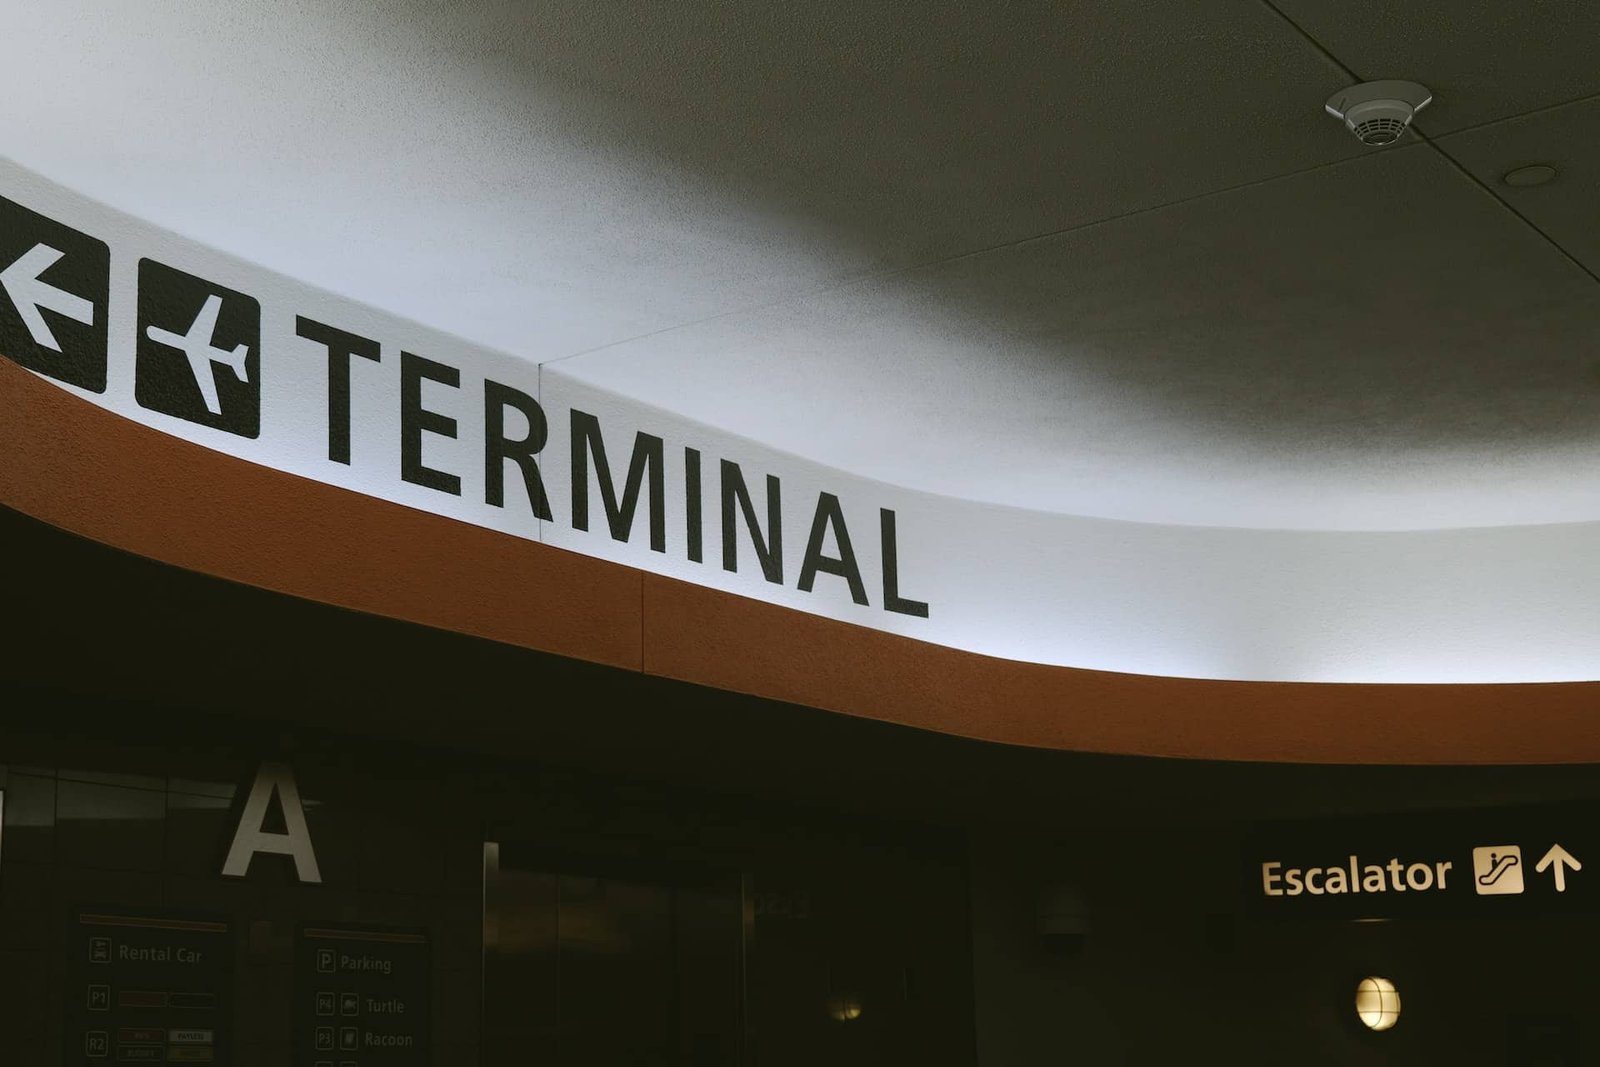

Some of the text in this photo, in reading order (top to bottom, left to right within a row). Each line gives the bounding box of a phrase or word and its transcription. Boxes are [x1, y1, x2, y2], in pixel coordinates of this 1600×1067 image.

[295, 314, 930, 619] TERMINAL
[221, 763, 322, 883] A
[1262, 856, 1453, 898] Escalator
[119, 944, 203, 964] Rental Car
[320, 952, 392, 974] P Parking
[91, 990, 106, 1007] P1
[366, 998, 405, 1014] Turtle
[89, 1037, 105, 1051] R2
[318, 1031, 413, 1046] P3 Racoon
